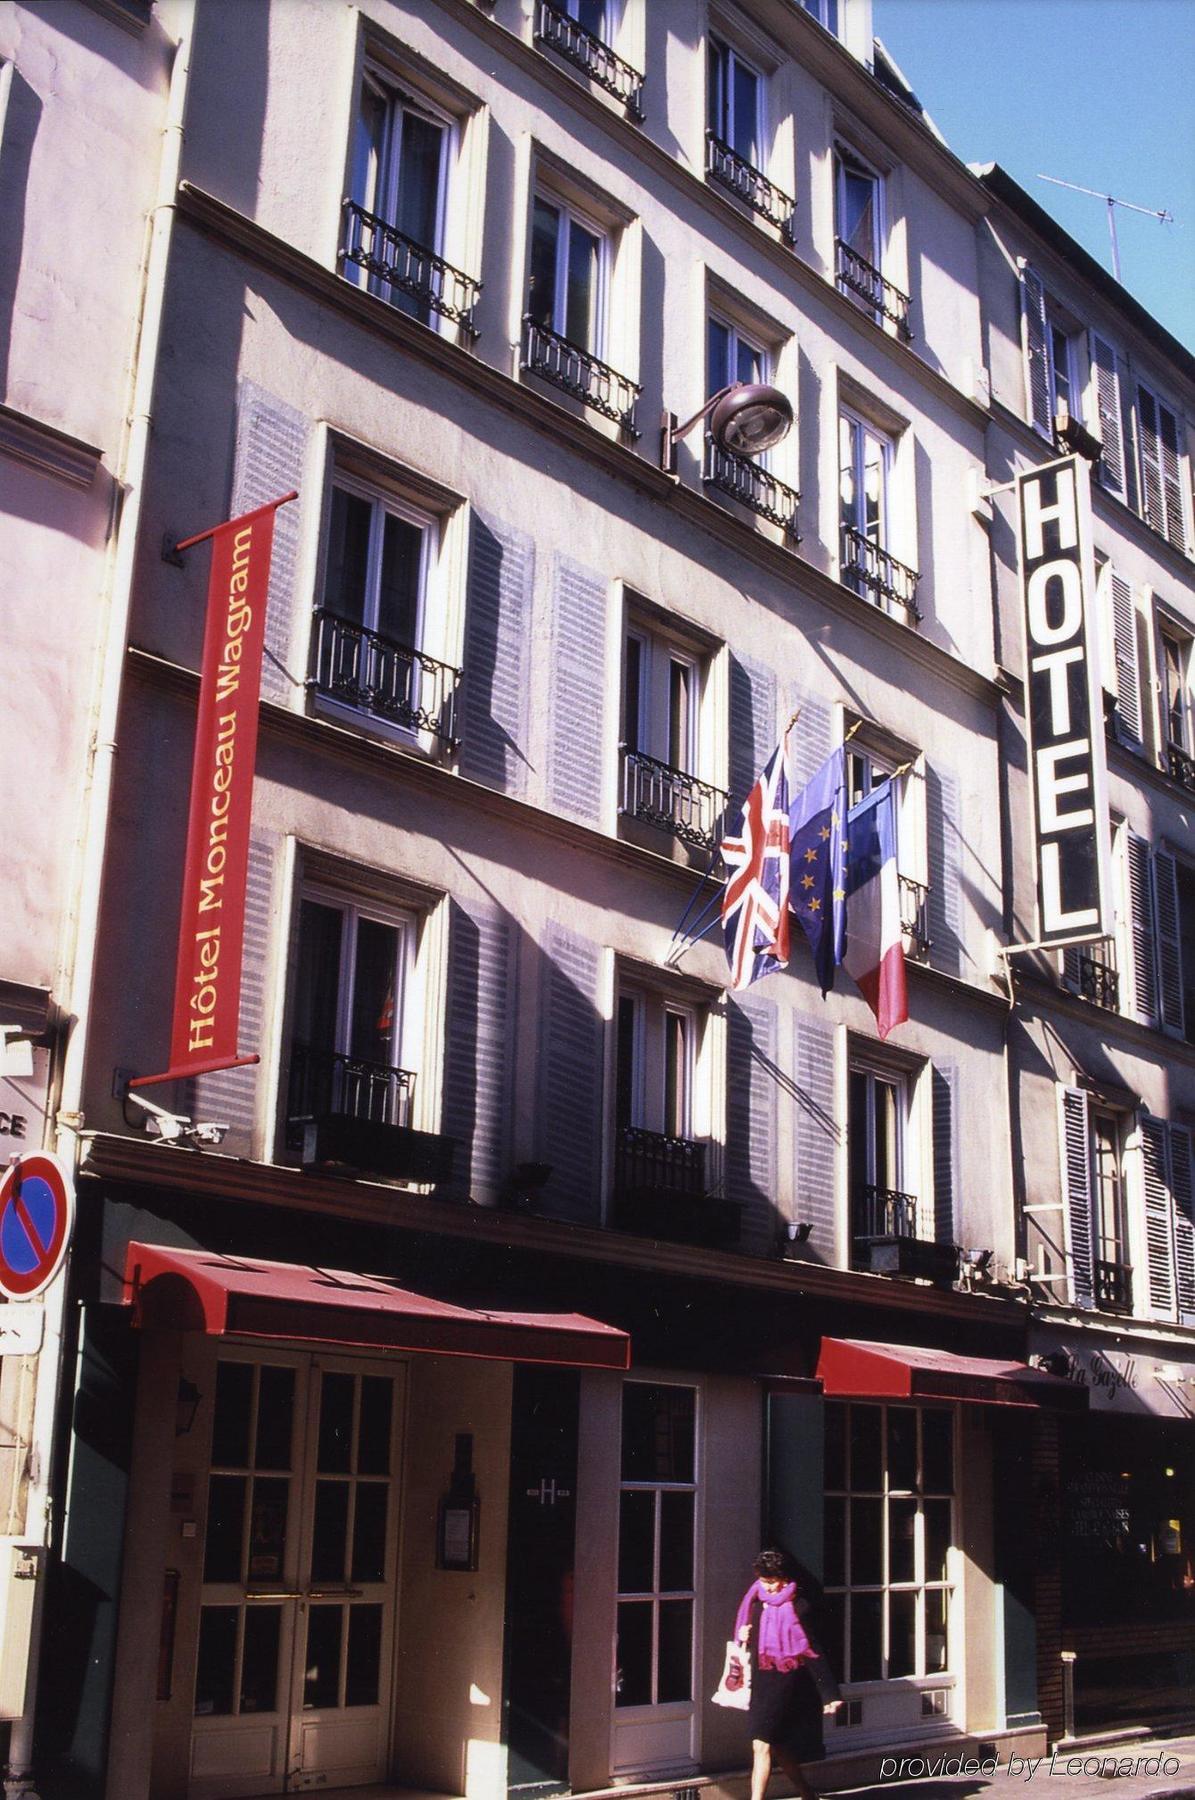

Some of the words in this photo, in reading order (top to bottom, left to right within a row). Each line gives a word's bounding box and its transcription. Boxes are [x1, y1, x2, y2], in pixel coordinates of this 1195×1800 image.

[216, 526, 253, 703] Wagram
[1023, 469, 1099, 932] HOTEL
[199, 710, 237, 914] Monceau
[189, 925, 222, 1053] Hôtel
[1090, 1356, 1138, 1400] Gazelle
